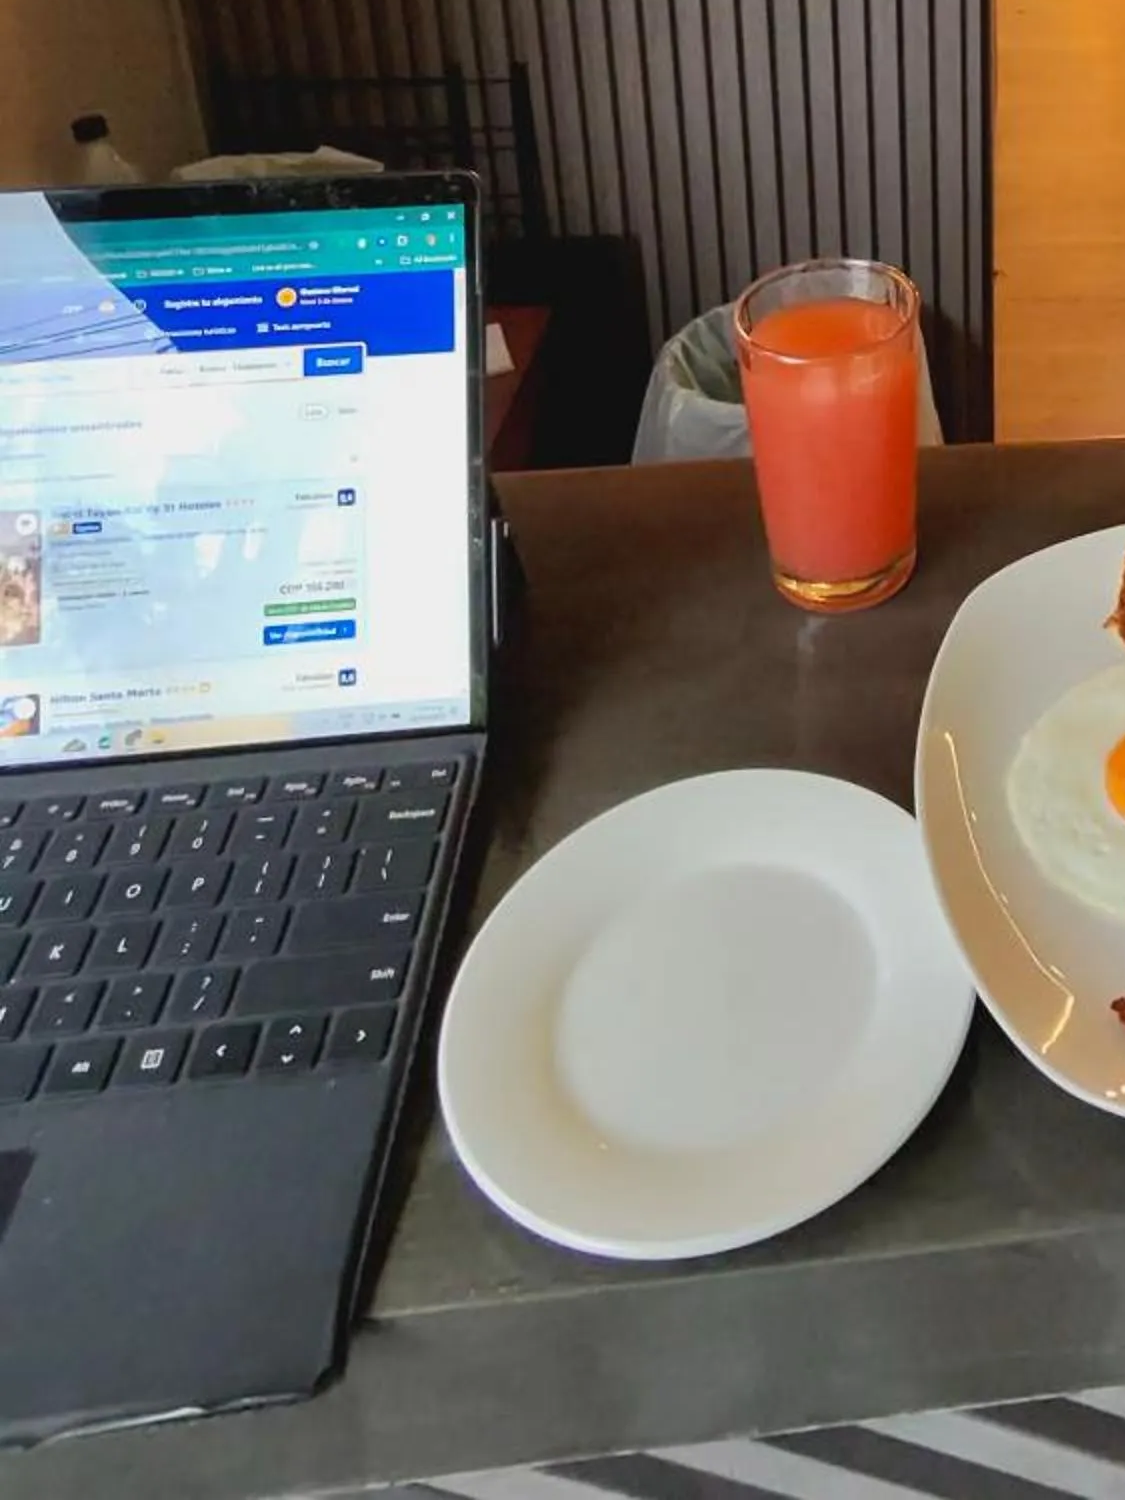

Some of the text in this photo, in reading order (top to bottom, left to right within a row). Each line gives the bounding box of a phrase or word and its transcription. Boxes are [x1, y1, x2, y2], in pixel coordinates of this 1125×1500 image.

[316, 356, 351, 368] Buscar
[388, 809, 436, 821] Backspace
[191, 877, 205, 892] P
[48, 944, 65, 961] K
[116, 937, 128, 953] L
[370, 967, 396, 982] Shift
